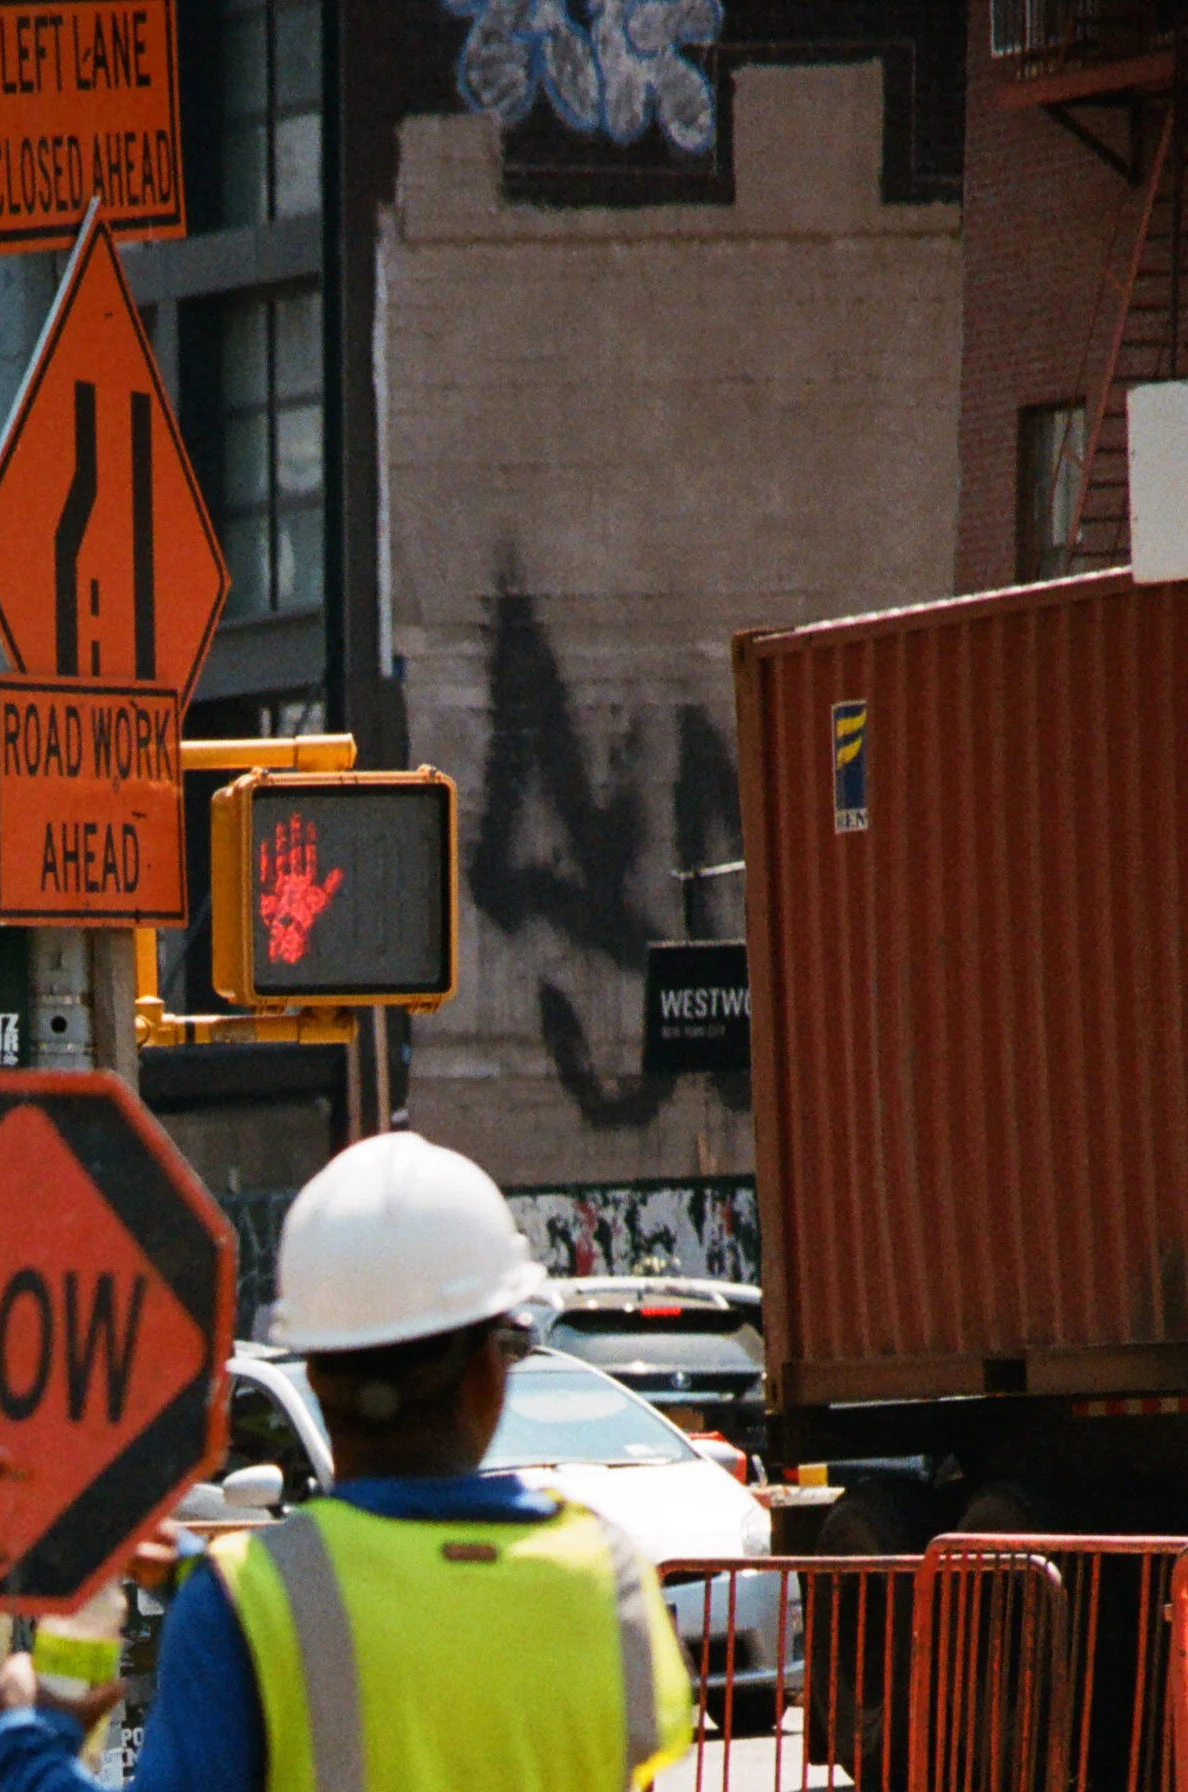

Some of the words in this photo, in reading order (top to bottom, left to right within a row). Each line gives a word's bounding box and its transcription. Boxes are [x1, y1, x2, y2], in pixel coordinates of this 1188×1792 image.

[0, 15, 63, 94] LEFT
[72, 11, 151, 91] LANE
[91, 129, 172, 208] AHEAD
[3, 702, 82, 778] ROAD
[91, 706, 174, 780] WORK
[40, 822, 140, 893] AHEAD
